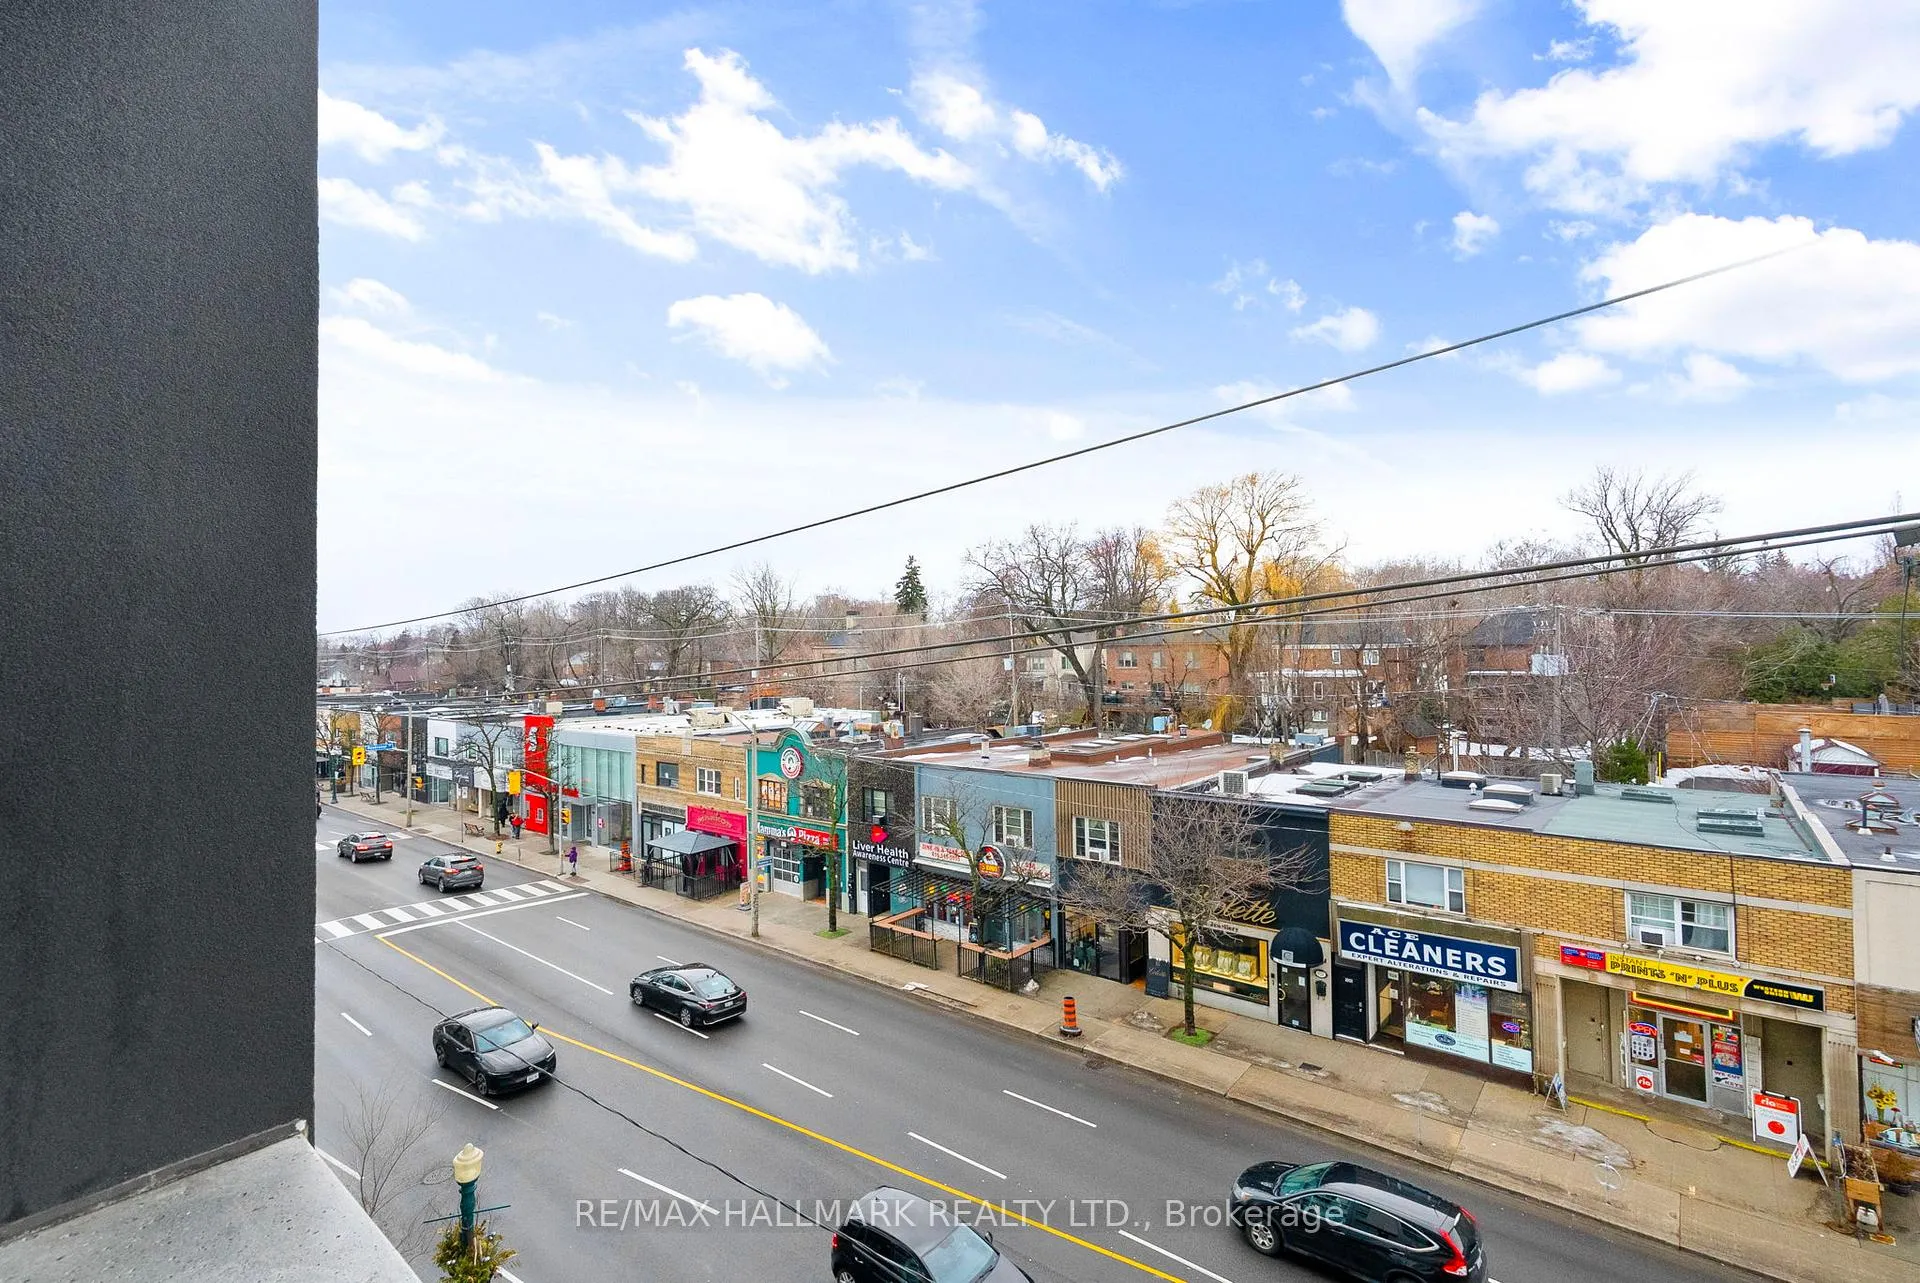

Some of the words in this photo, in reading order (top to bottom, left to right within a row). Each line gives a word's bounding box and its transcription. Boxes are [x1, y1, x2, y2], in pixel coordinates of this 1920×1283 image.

[798, 830, 821, 846] Pizza
[852, 840, 876, 855] Liver
[876, 843, 909, 860] Health
[852, 850, 887, 864] Awareness
[887, 855, 910, 868] Centre
[1370, 927, 1420, 941] ACE
[1349, 932, 1507, 977] CLEANERS
[1609, 955, 1648, 967] INSTANT
[1351, 952, 1384, 965] EXPERT
[1387, 959, 1449, 976] ALTERATIONS
[1452, 971, 1460, 979] &
[1463, 974, 1507, 988] REPAIRS
[1610, 961, 1666, 980] PRINTS
[1696, 976, 1739, 993] PLUS
[1630, 1023, 1657, 1037] OPEN
[1638, 1077, 1652, 1087] ria
[1760, 1097, 1776, 1107] ria
